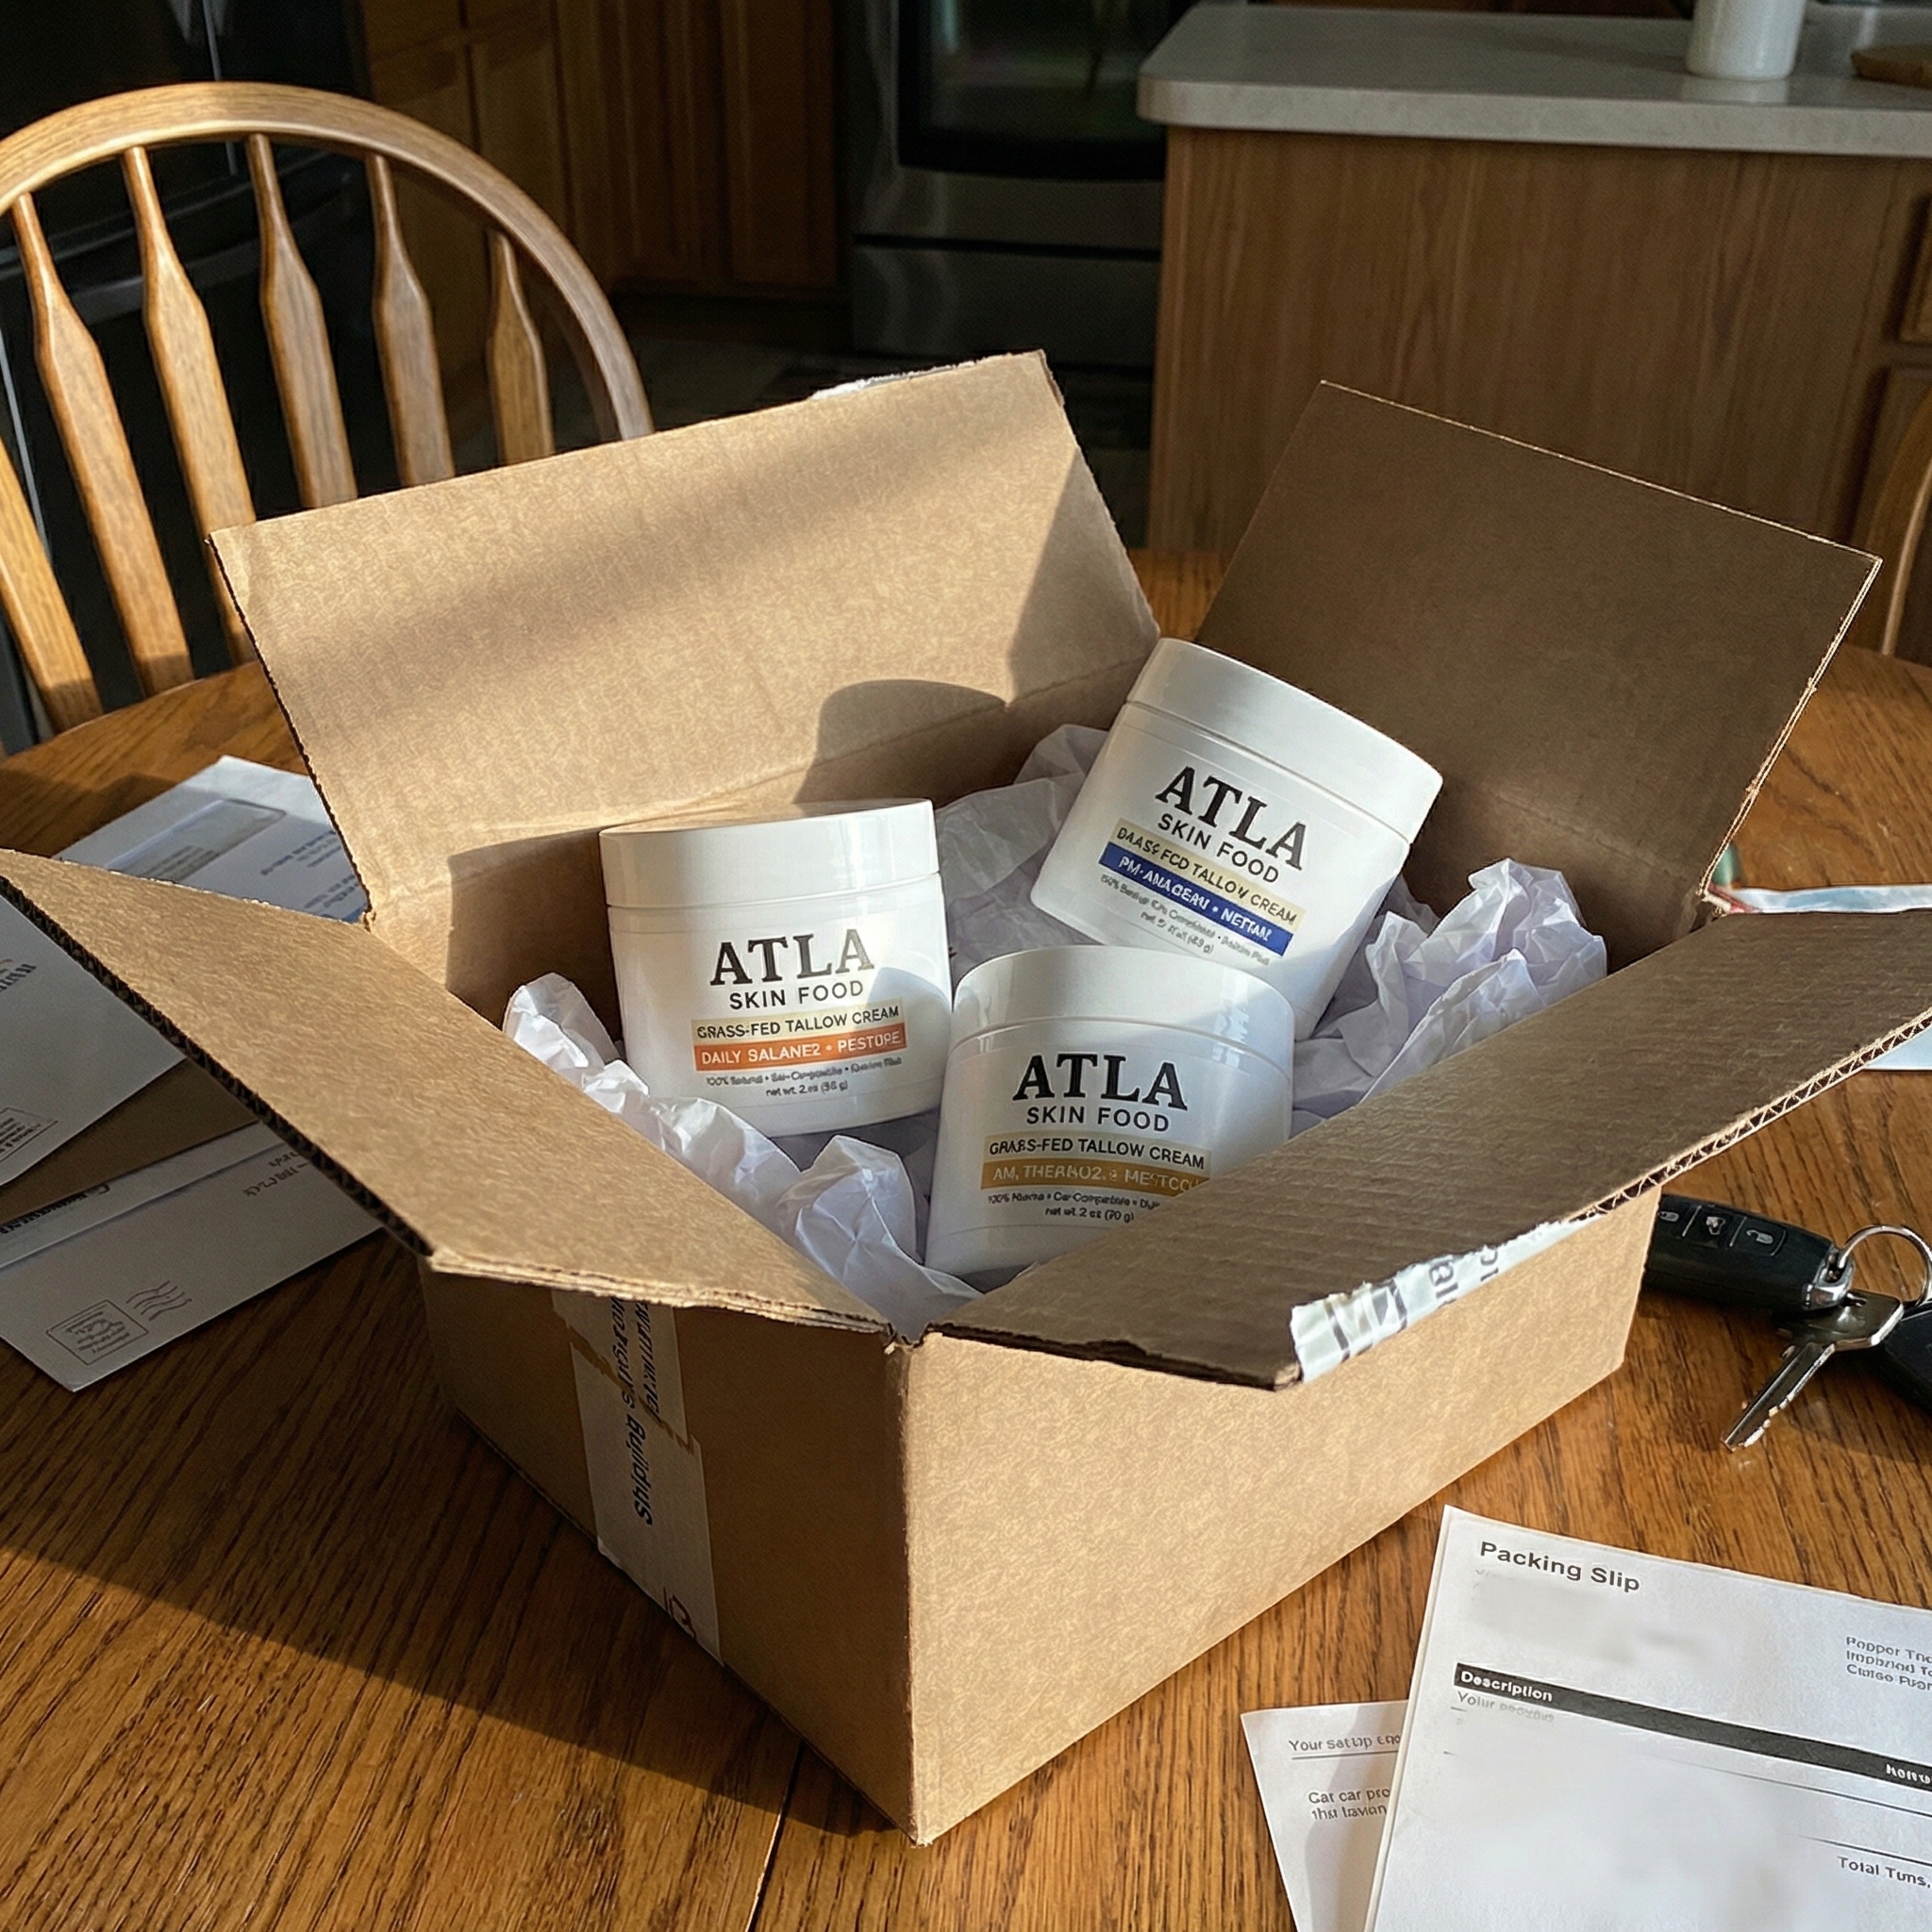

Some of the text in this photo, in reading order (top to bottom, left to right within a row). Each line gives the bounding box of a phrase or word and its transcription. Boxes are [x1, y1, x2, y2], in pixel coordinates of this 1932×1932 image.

[1155, 765, 1307, 871] ATLA
[1158, 813, 1279, 883] SKIN FOOD
[1250, 893, 1297, 924] CREAM
[709, 928, 874, 986] ATLA
[729, 979, 864, 1010] SKIN FOOD
[785, 1014, 848, 1033] TALLOW
[852, 1005, 899, 1024] CREAM
[701, 1050, 741, 1065] DAILY
[1012, 1053, 1189, 1111] ATLA
[1026, 1105, 1170, 1132] SKIN FOOD
[1077, 1138, 1145, 1158] TALLOW
[1149, 1146, 1205, 1170] CREAM
[1479, 1541, 1641, 1593] Packing Slip
[1289, 1740, 1324, 1752] Your
[1838, 1856, 1880, 1875] Total
